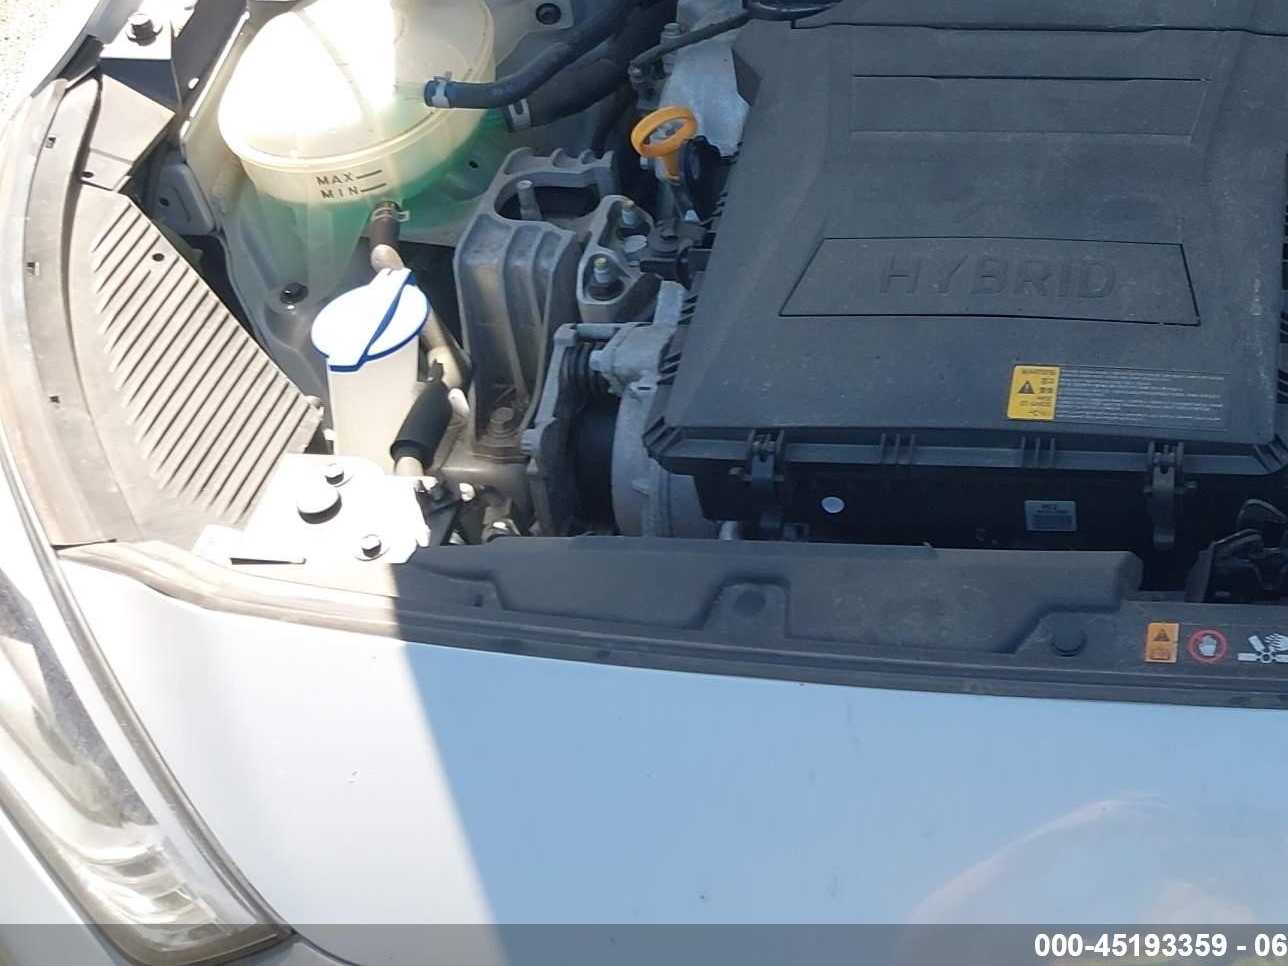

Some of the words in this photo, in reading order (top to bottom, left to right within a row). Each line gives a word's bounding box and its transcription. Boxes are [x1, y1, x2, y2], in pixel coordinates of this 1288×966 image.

[315, 172, 355, 186] MAX
[320, 186, 359, 199] MIN
[878, 254, 1117, 299] HYBRID
